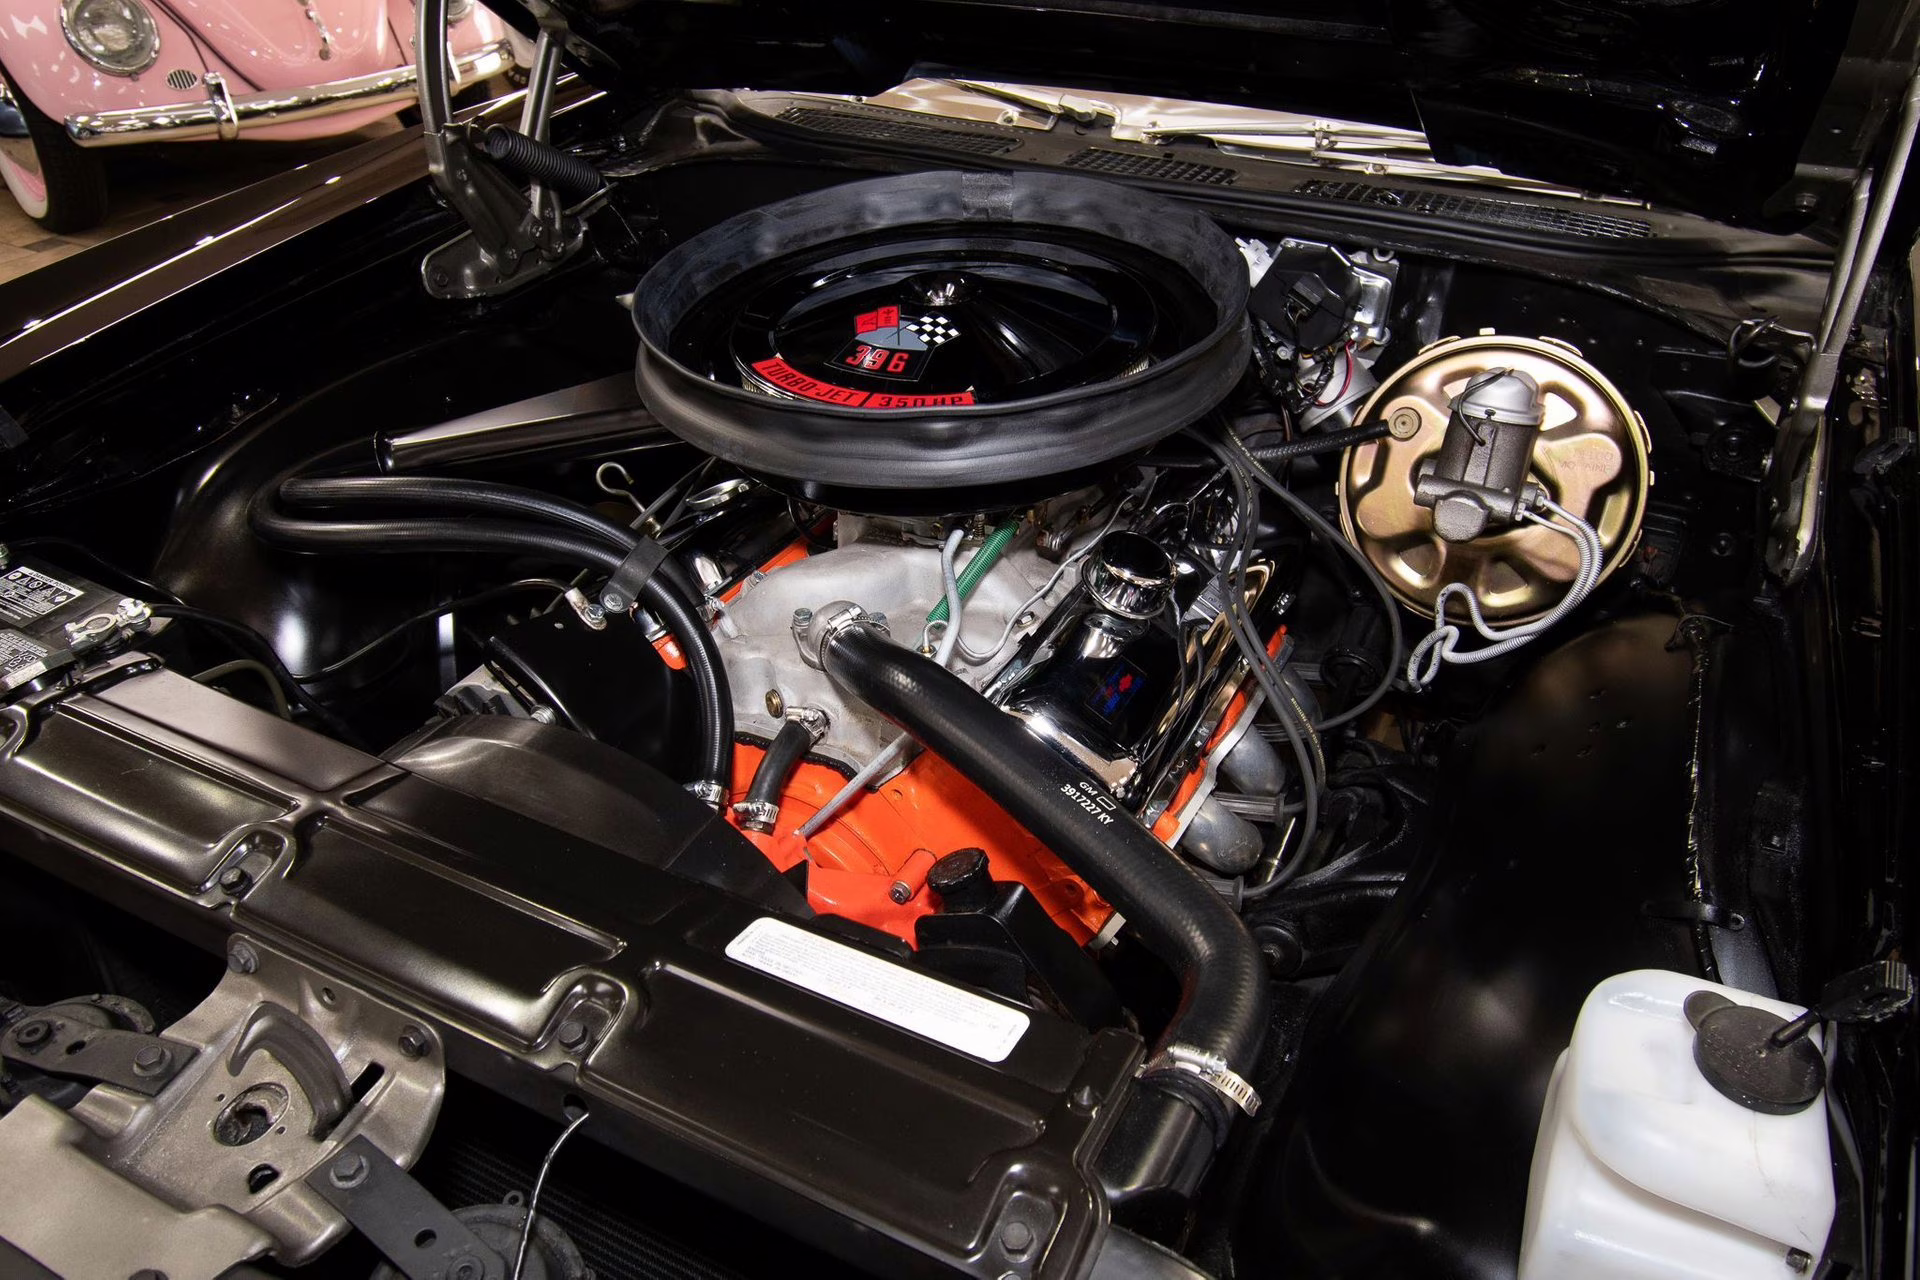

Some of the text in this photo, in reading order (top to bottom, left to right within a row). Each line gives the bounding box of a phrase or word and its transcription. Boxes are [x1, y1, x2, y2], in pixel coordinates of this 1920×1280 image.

[845, 344, 909, 373] 396
[762, 362, 859, 403] TURBO-JET
[1060, 783, 1114, 825] 3917227 KY
[1079, 781, 1098, 796] GM
